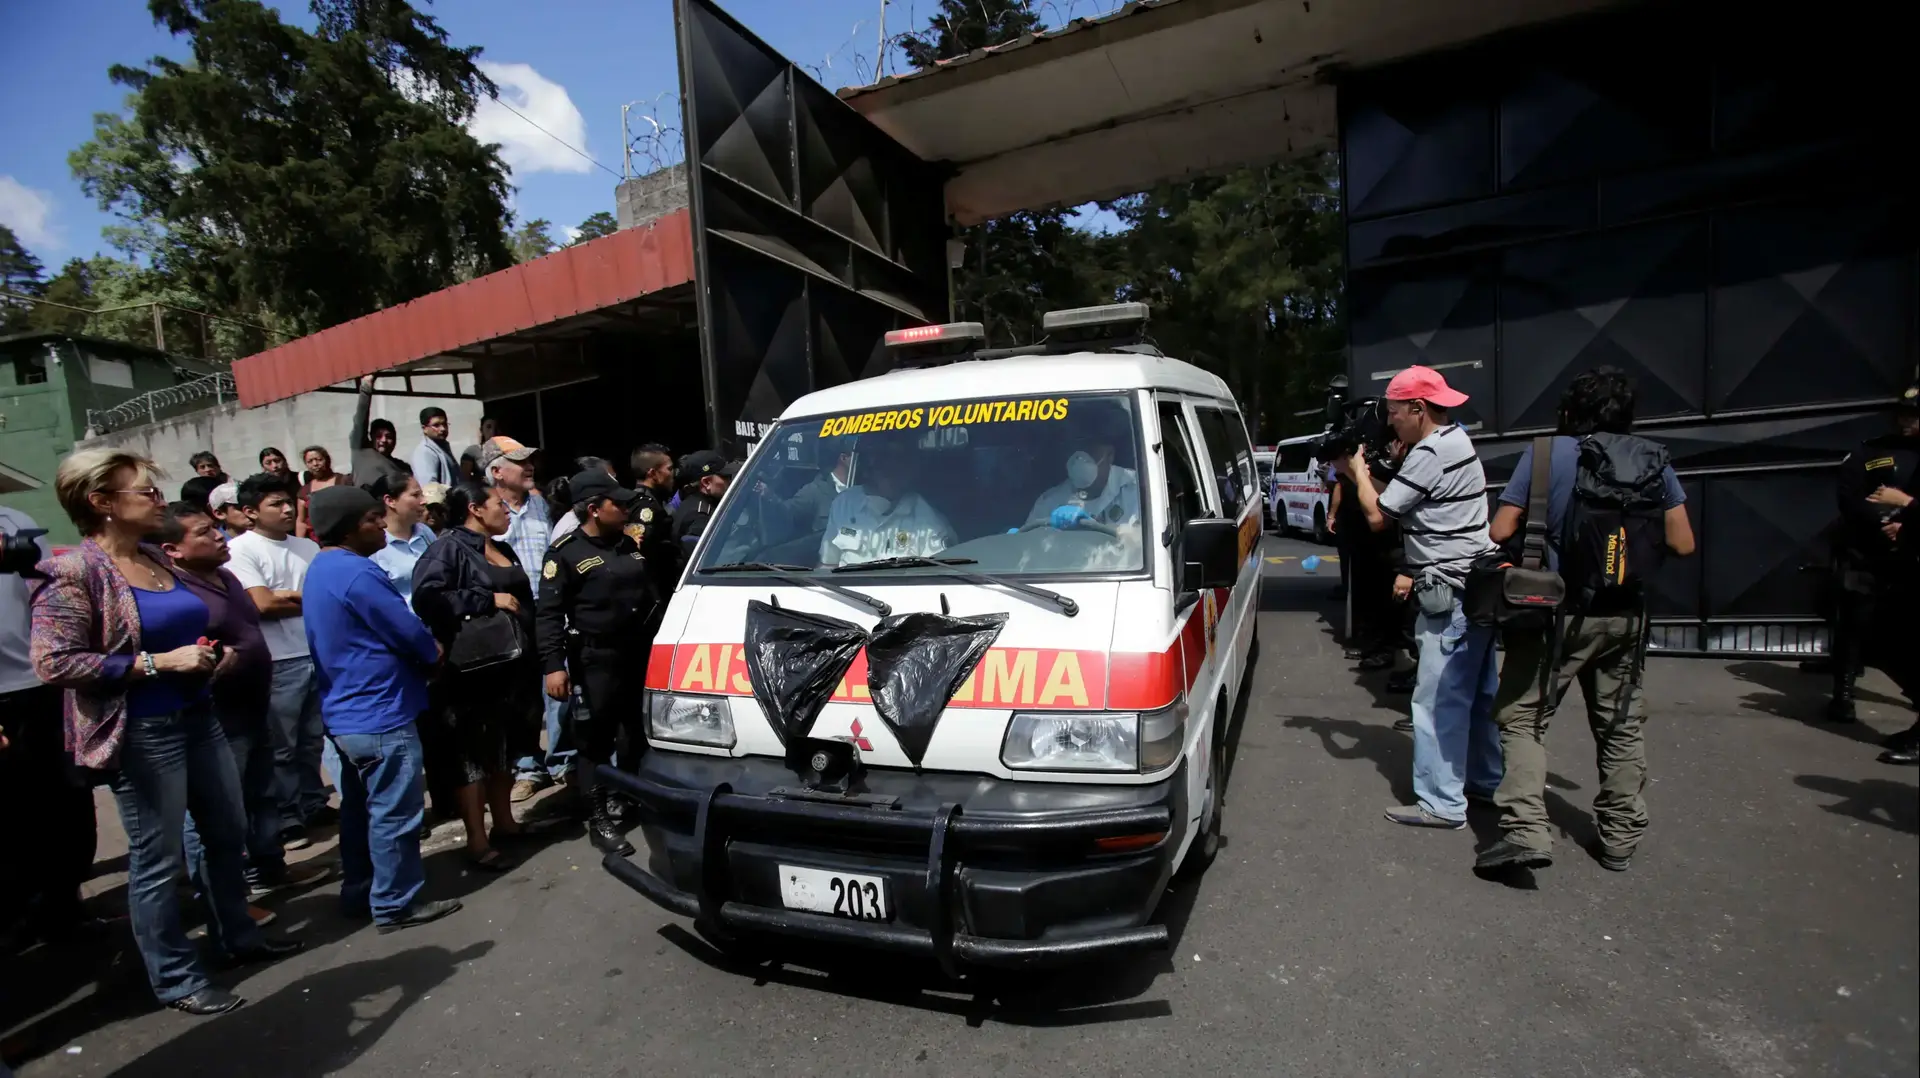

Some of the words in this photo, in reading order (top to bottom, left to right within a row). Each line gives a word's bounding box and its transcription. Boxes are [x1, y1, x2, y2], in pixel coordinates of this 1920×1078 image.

[735, 420, 756, 437] BAJE
[819, 409, 924, 437] BOMBEROS
[928, 398, 1069, 427] VOLUNTARIOS
[1605, 534, 1618, 575] Marmot
[830, 877, 882, 921] 203
